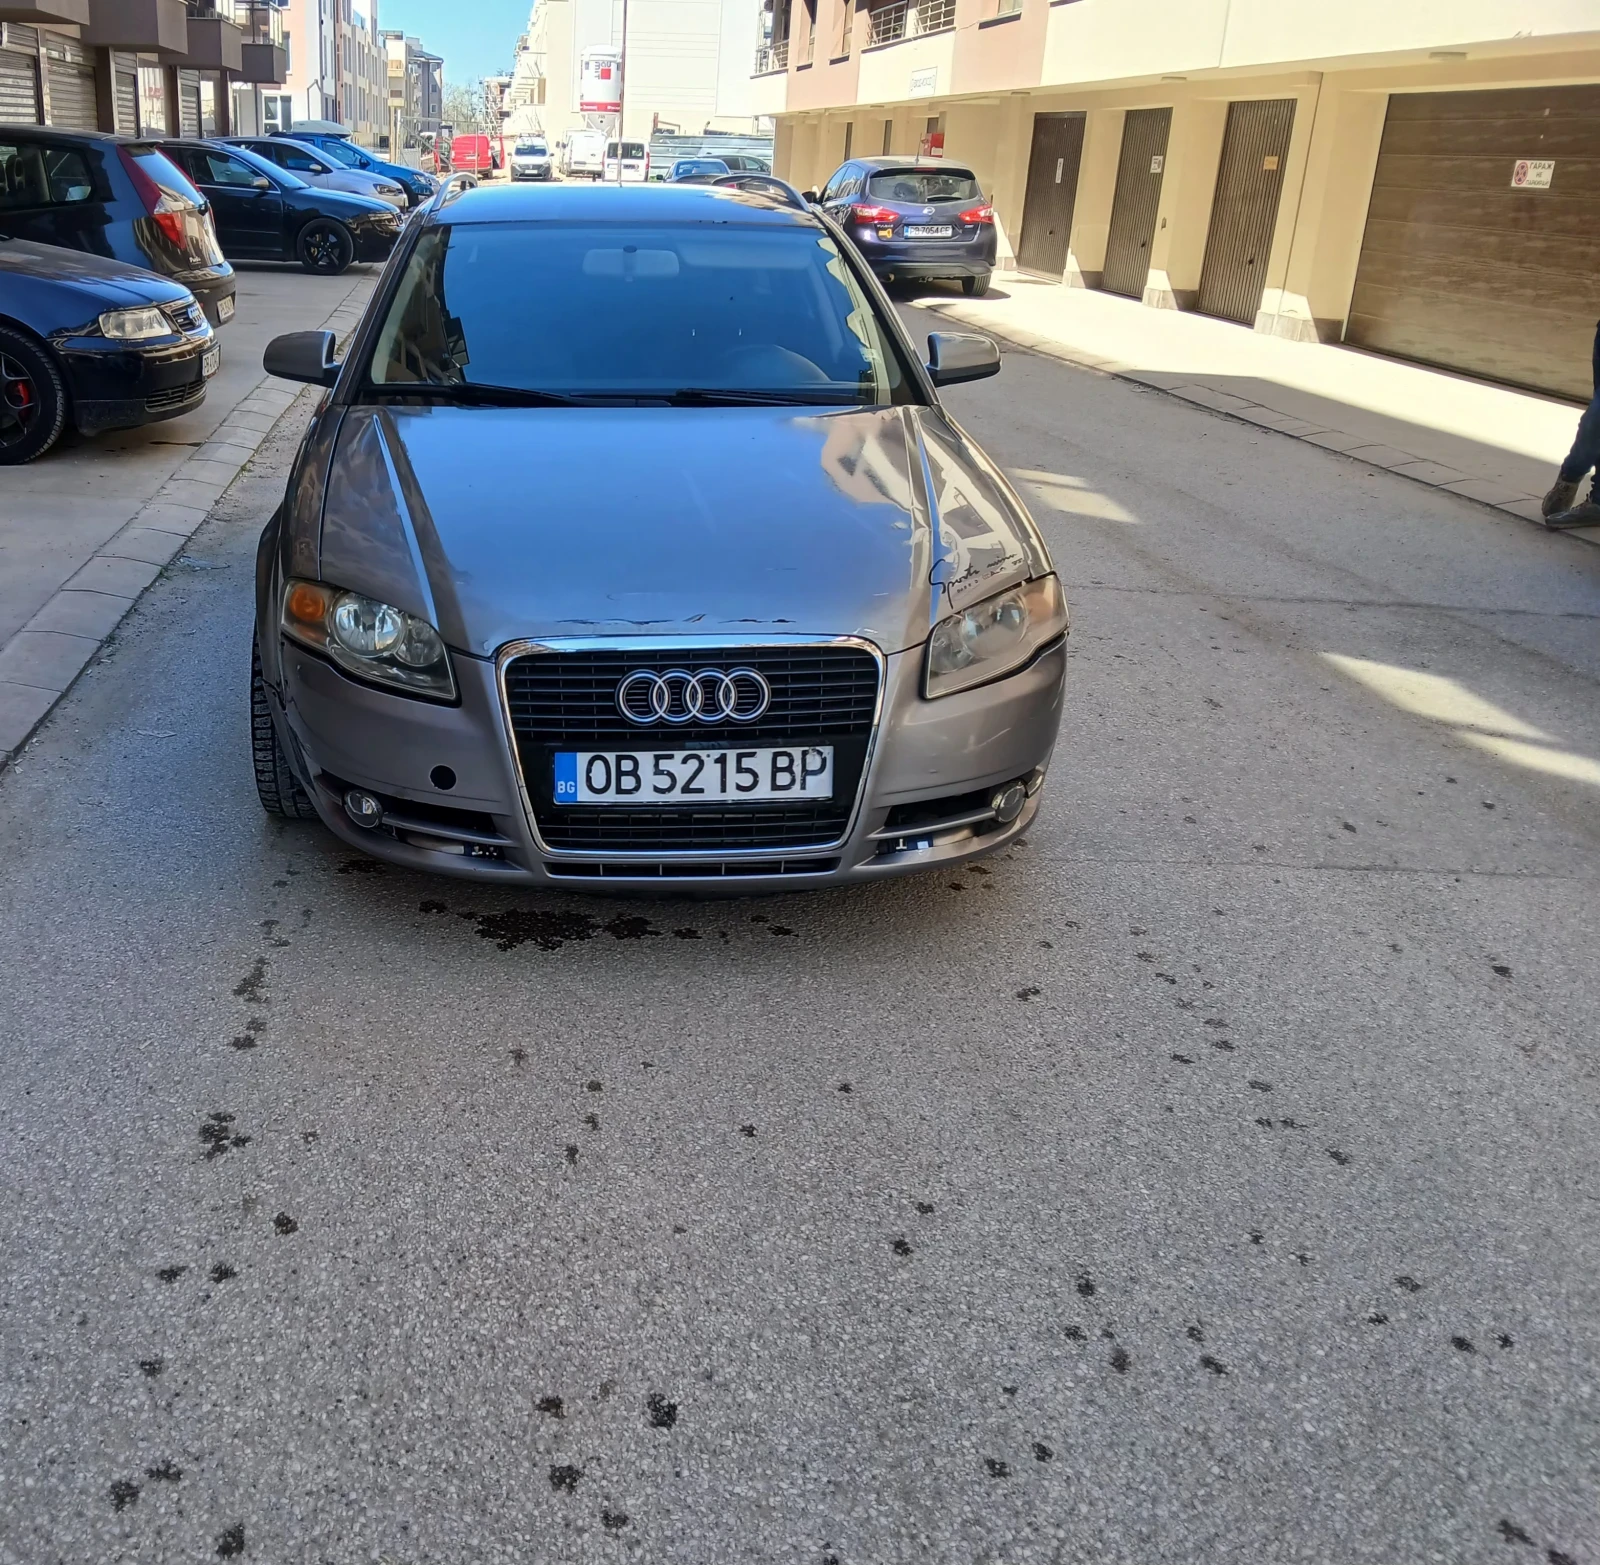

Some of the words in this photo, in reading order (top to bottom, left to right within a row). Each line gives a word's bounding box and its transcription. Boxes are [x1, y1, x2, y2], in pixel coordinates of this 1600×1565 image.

[1529, 162, 1554, 170] ГАРАЖ
[585, 754, 642, 795] OB
[652, 751, 760, 795] 5215
[770, 748, 828, 792] BP
[557, 781, 576, 793] BG
